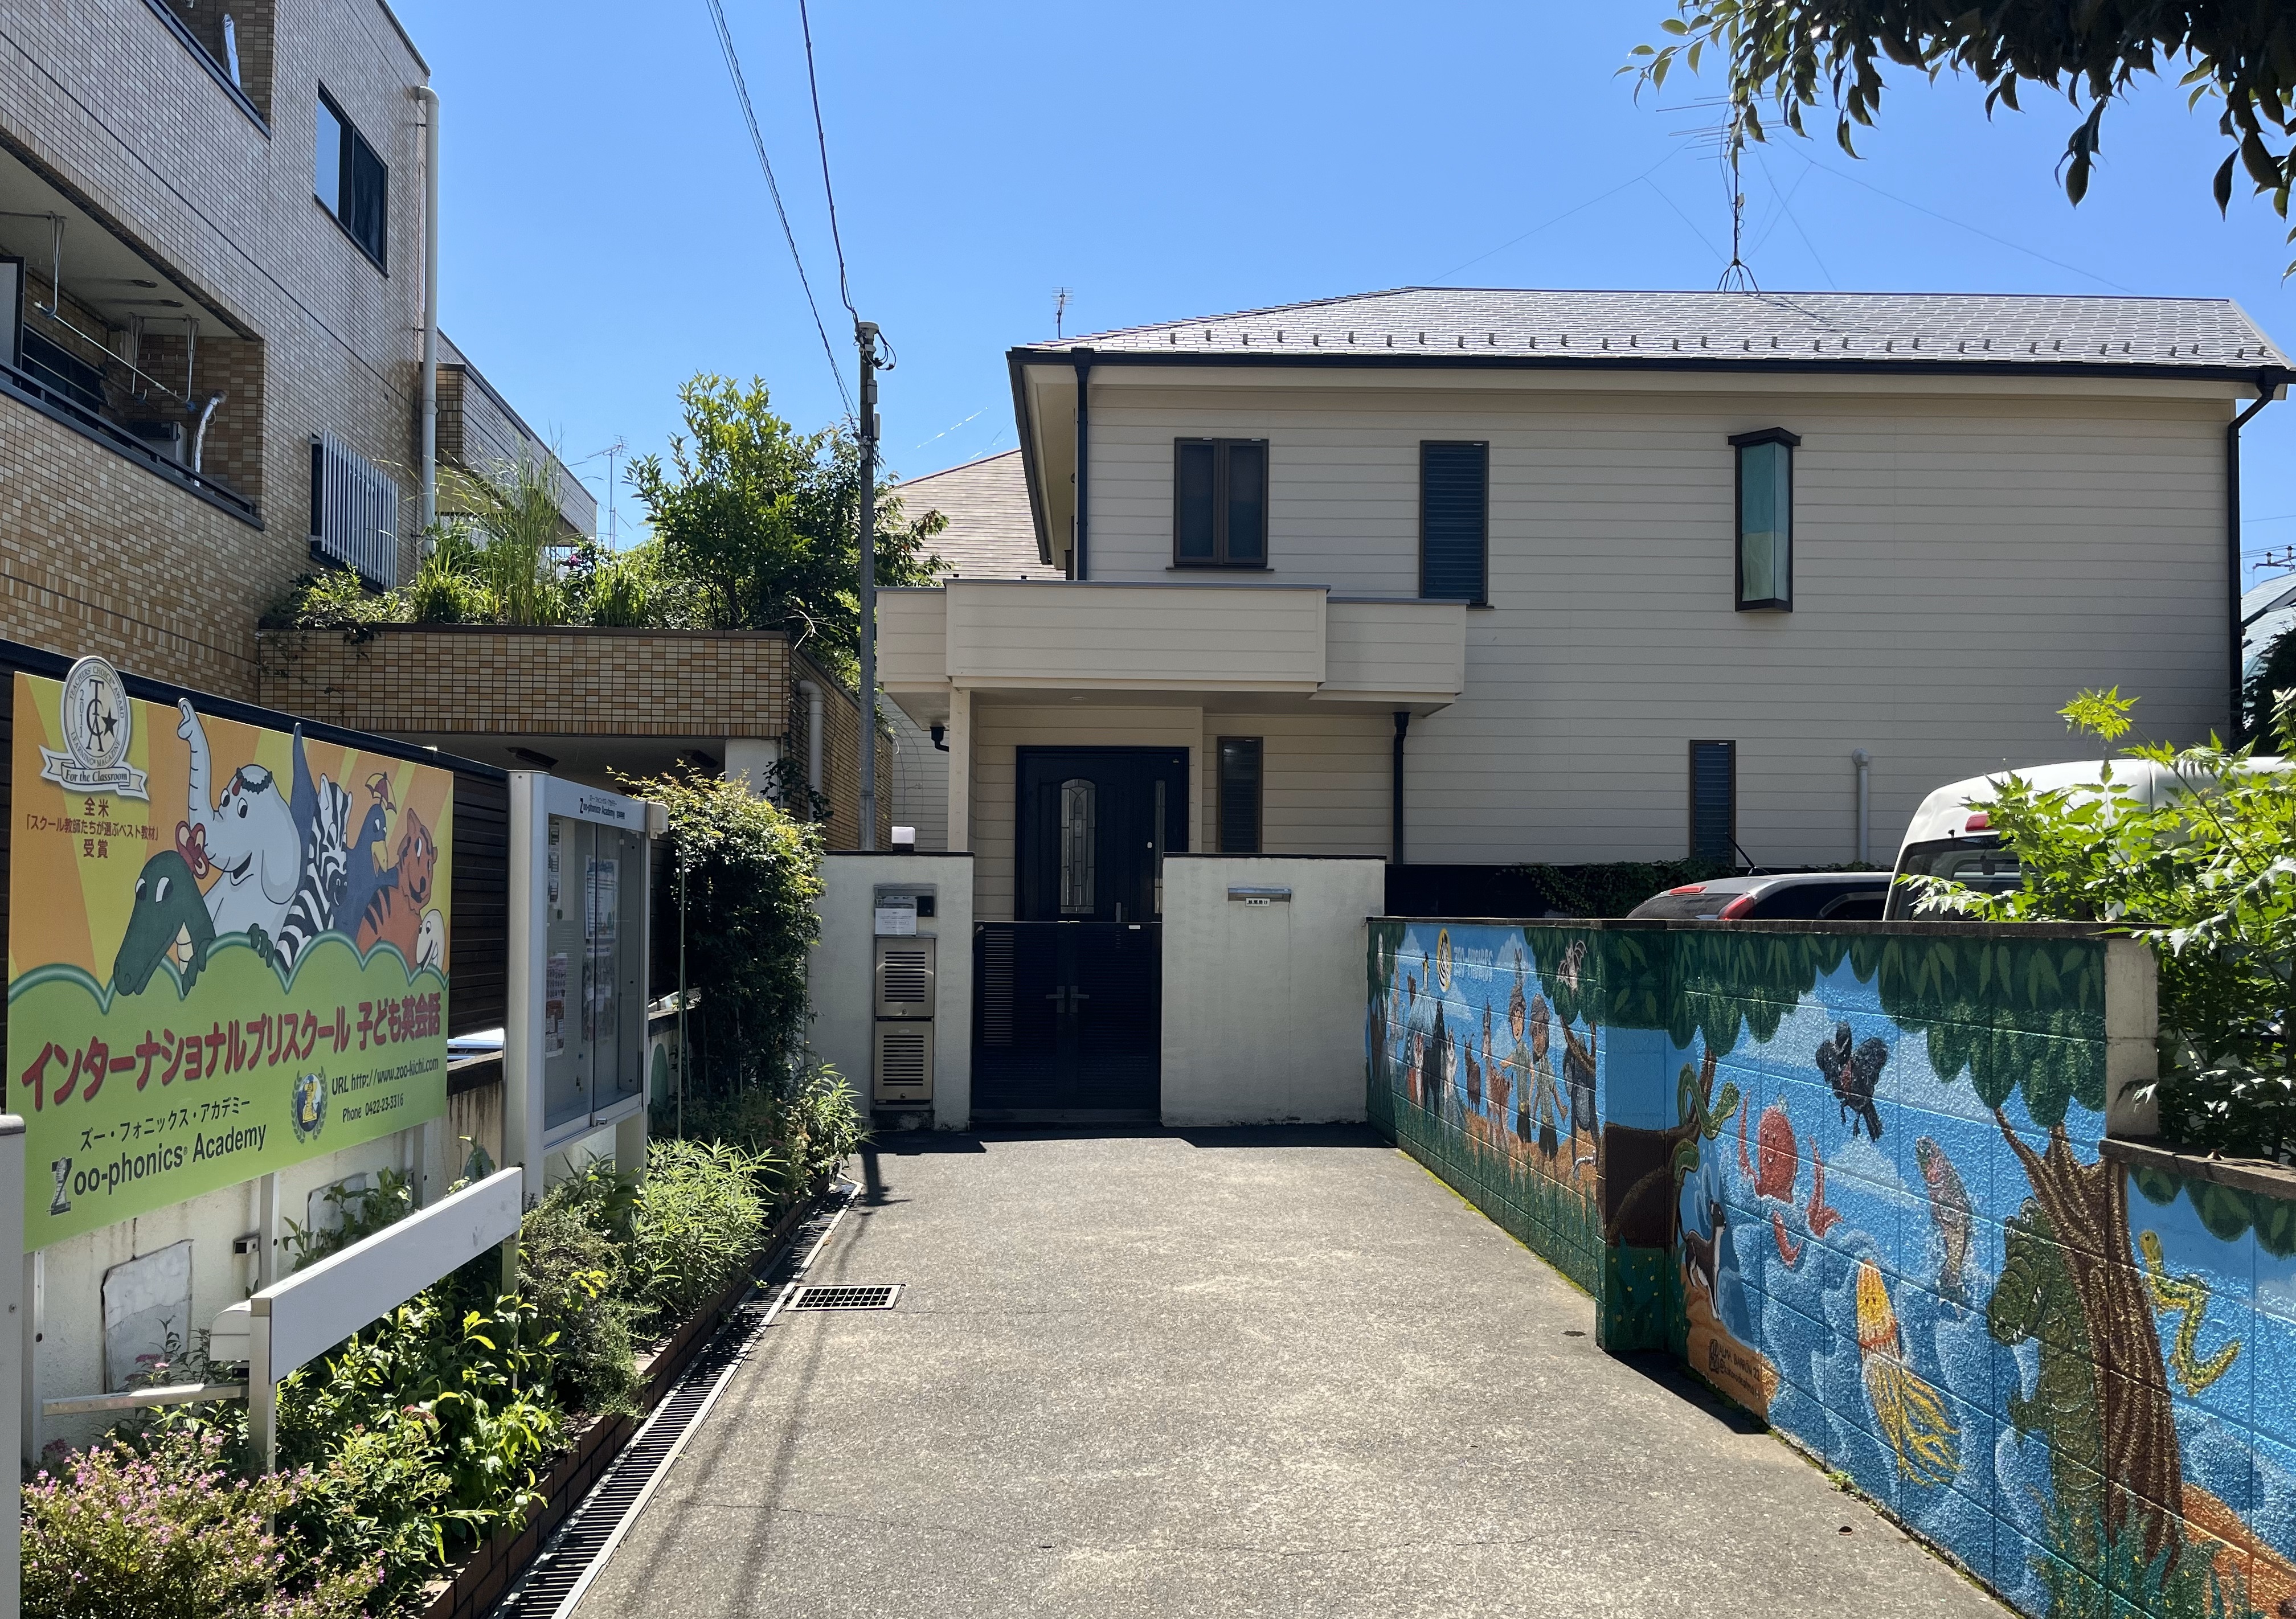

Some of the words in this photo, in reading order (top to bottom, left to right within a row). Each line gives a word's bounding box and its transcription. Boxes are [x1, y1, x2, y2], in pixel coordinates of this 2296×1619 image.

[114, 687, 125, 719] AWARD
[96, 740, 121, 767] MAGAZINE
[66, 770, 77, 782] For
[79, 770, 90, 782] the
[92, 770, 128, 782] Classroom
[84, 796, 109, 818] 全米
[27, 814, 158, 841] 「スクール教師たちが選ぶベスト教材」
[83, 838, 108, 859] 受賞
[21, 1005, 351, 1112] インターナショナルプリスクール
[357, 992, 441, 1051] 子ども英会話
[332, 1076, 349, 1096] URL
[351, 1058, 439, 1091] http://www.zoo-kichi.com
[342, 1107, 362, 1123] Phone
[365, 1093, 404, 1117] 0422-23-3316
[80, 1097, 250, 1151] ズー・フォニックス・アカデミー
[192, 1124, 267, 1163] Academy
